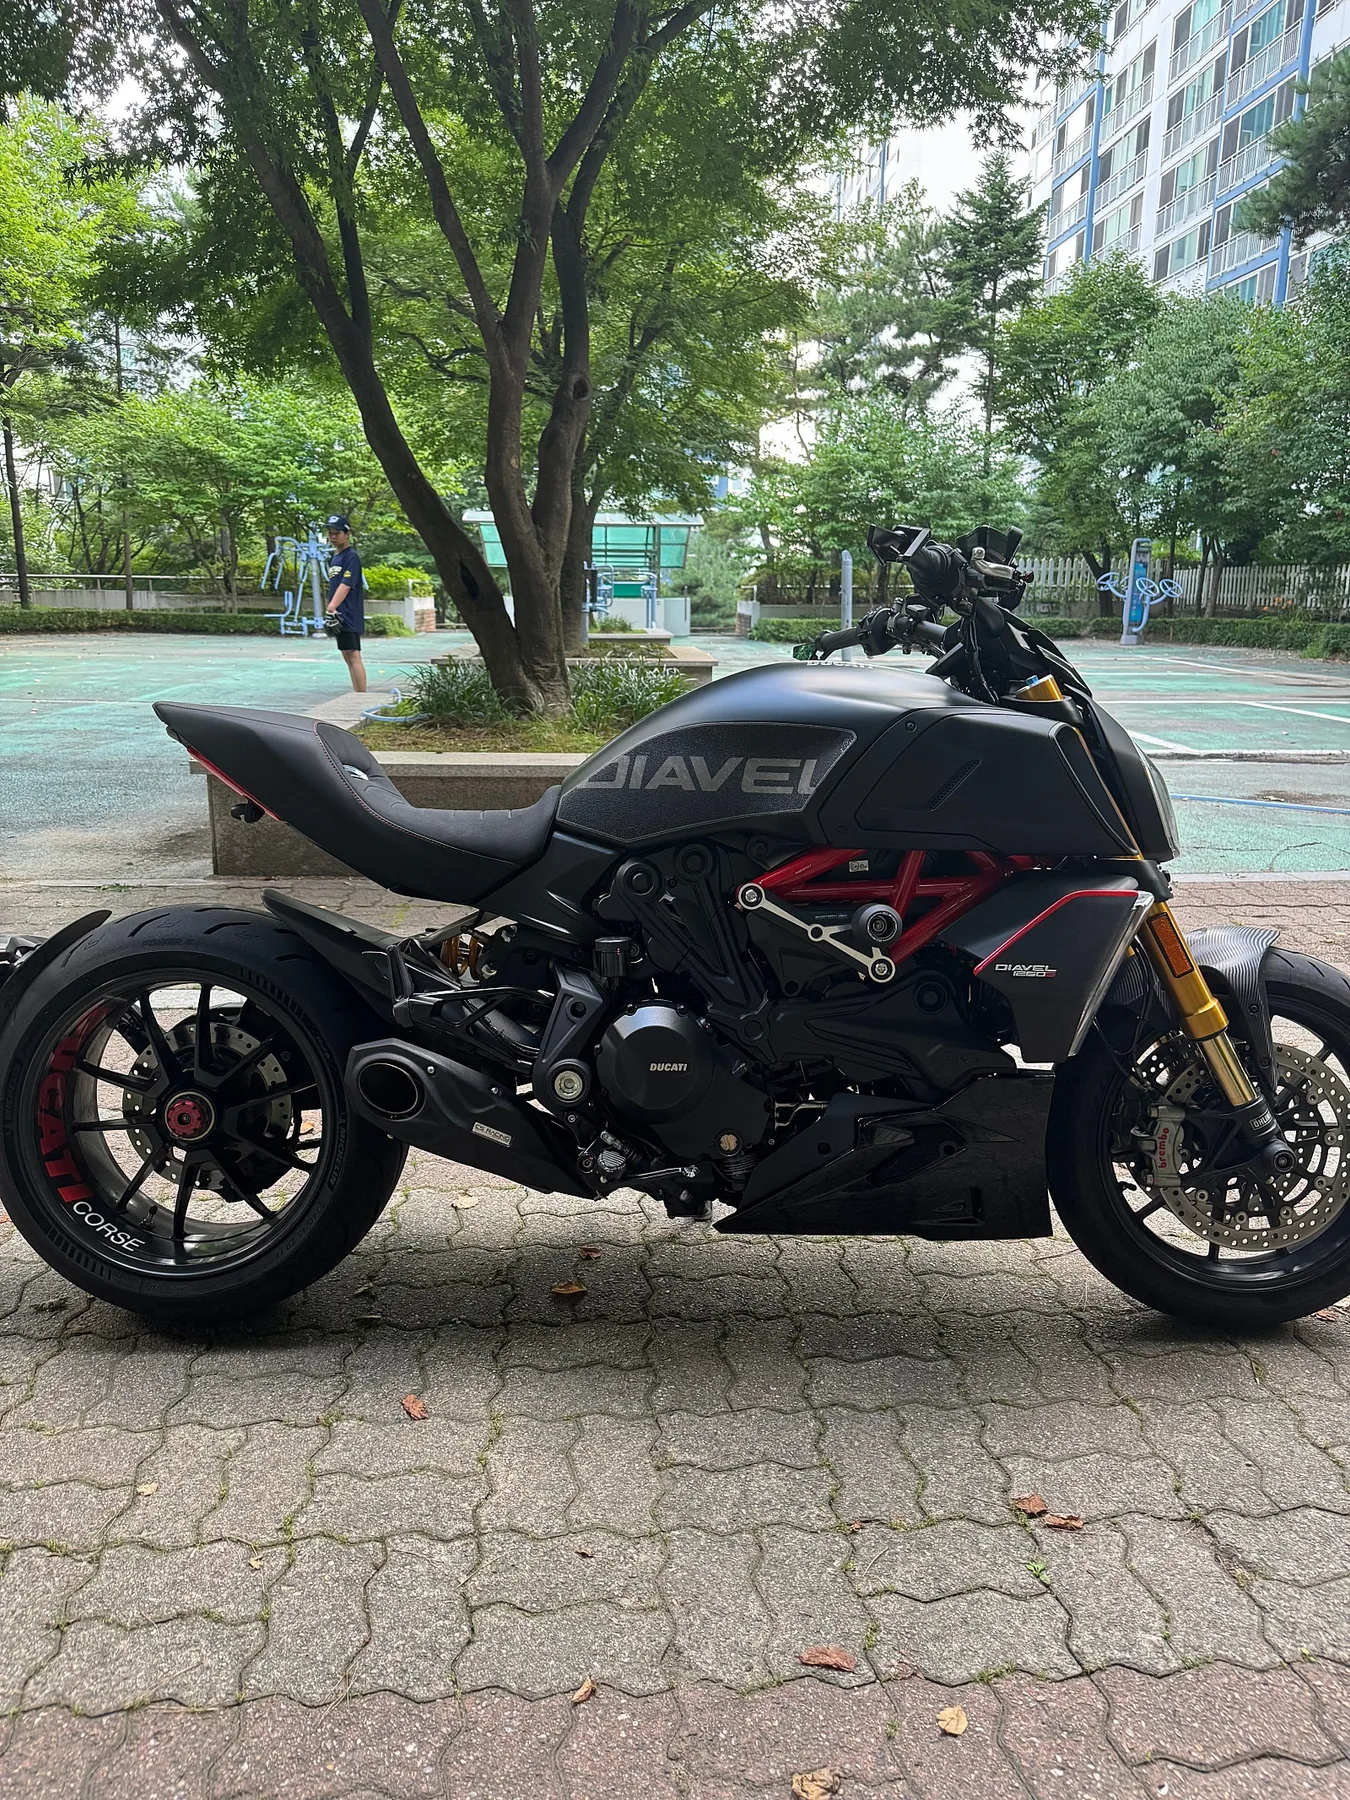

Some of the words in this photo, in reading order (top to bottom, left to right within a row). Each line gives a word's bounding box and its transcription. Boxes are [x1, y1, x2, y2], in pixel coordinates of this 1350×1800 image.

[994, 964, 1057, 972] DIAVEL
[649, 1063, 688, 1071] DUCATI
[486, 1127, 511, 1143] RACING
[1158, 1127, 1170, 1169] brembo
[329, 1126, 346, 1186] MICHELIN
[73, 1201, 145, 1252] CORSE
